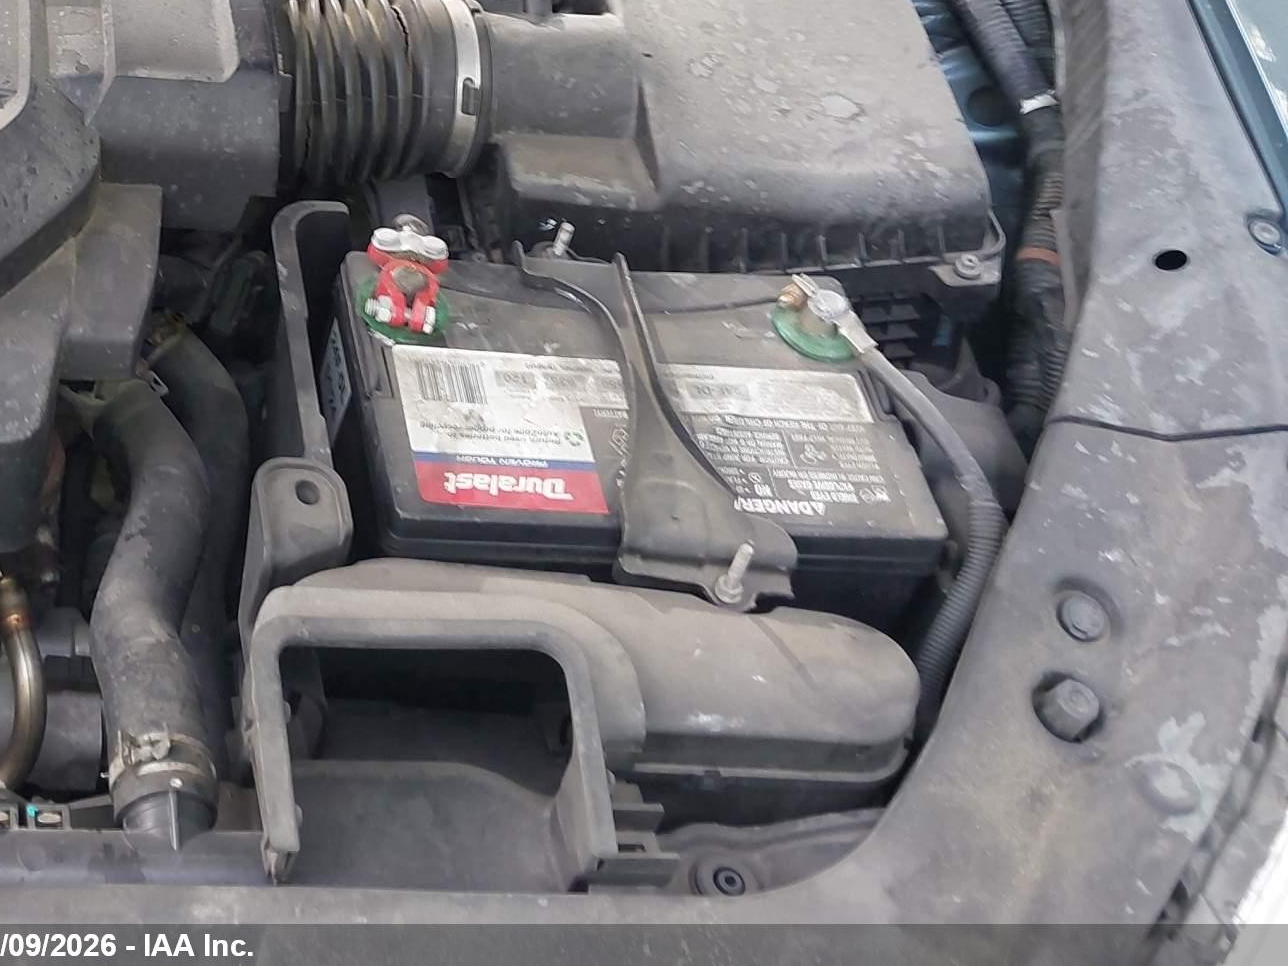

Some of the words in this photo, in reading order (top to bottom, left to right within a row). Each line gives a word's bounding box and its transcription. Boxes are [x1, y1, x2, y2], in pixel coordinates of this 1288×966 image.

[460, 432, 501, 442] batteries
[455, 455, 497, 466] TOUGH
[498, 457, 549, 468] PROVEN
[442, 471, 574, 502] Duralast
